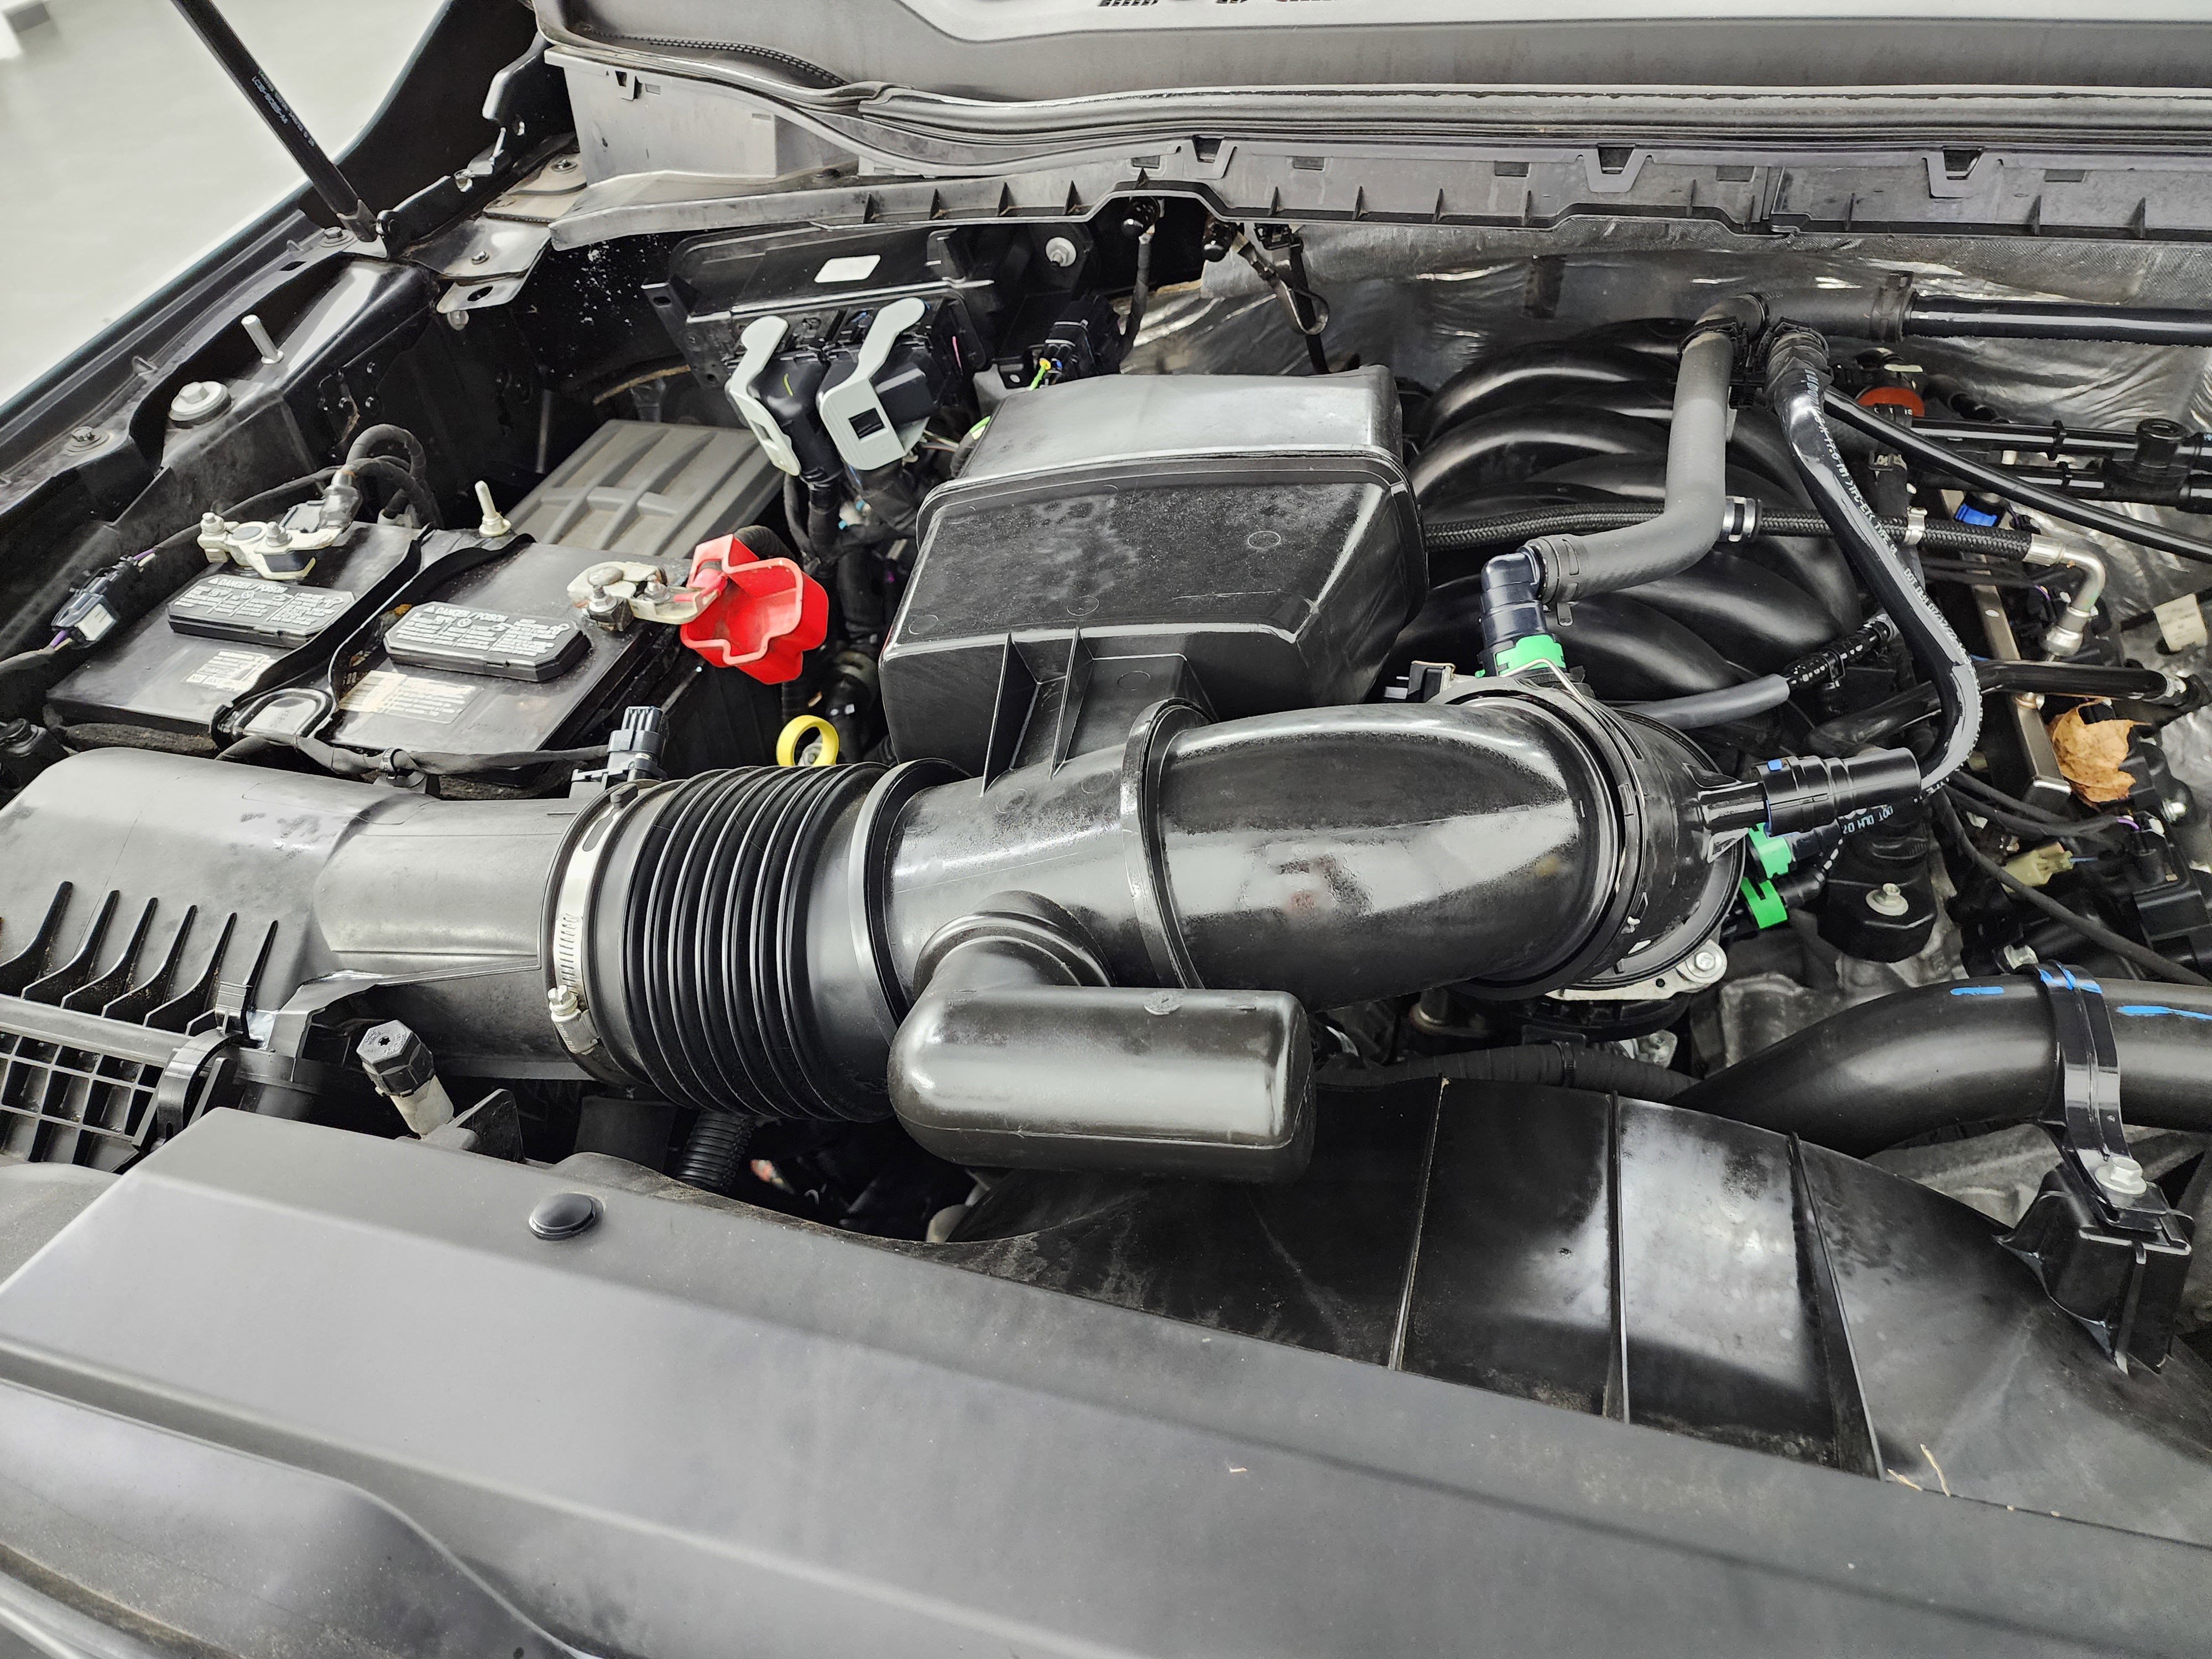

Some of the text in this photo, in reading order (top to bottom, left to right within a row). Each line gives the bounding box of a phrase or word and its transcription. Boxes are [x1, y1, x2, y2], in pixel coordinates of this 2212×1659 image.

[1874, 521, 1891, 544] TYPE
[219, 578, 251, 590] DANGER
[255, 583, 289, 594] POISON
[435, 607, 471, 618] DANGER
[474, 612, 509, 623] POISON
